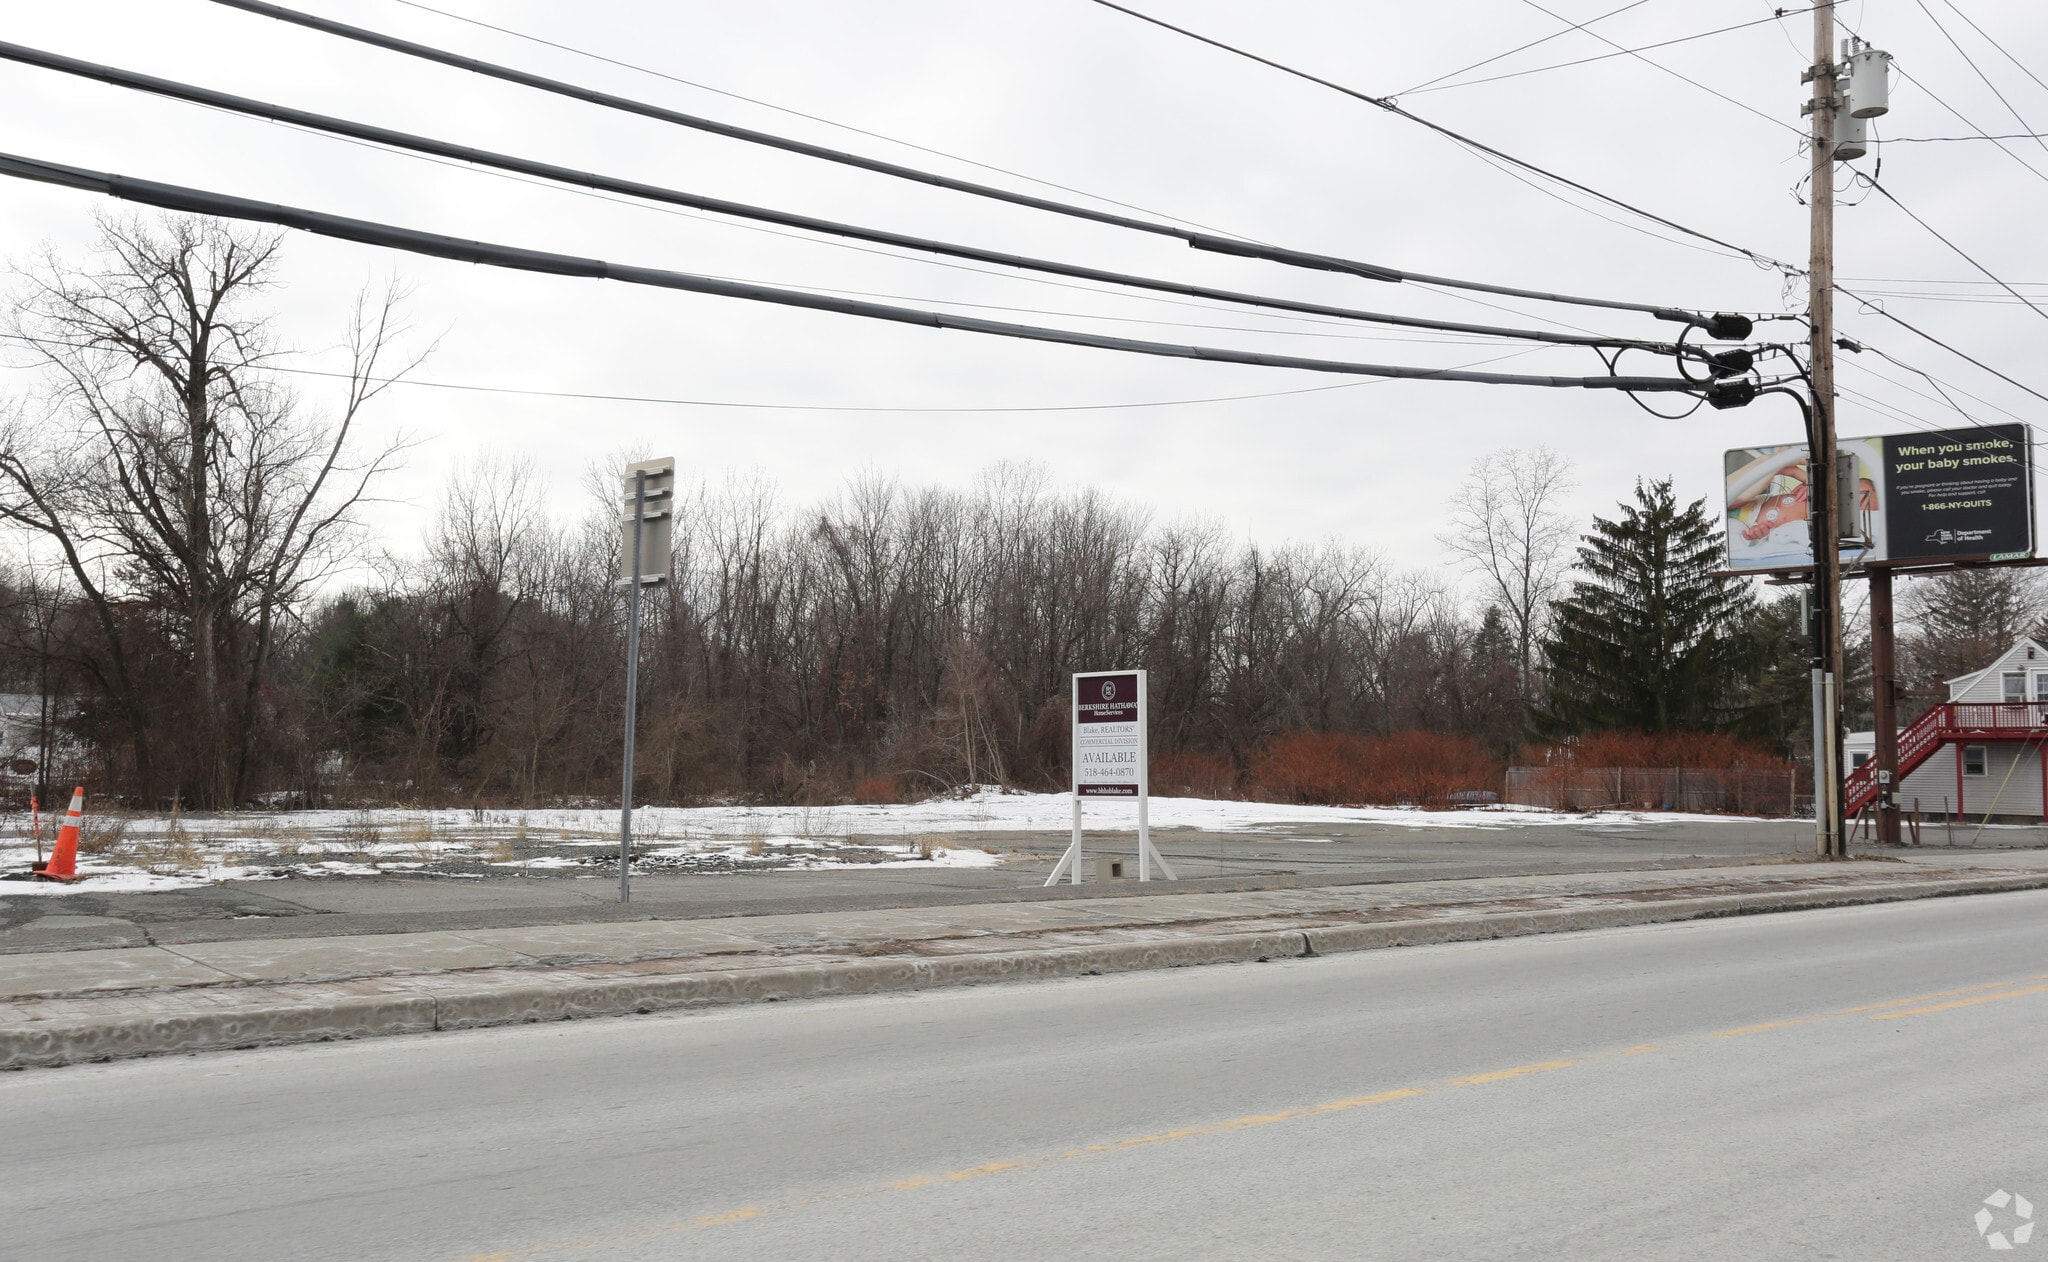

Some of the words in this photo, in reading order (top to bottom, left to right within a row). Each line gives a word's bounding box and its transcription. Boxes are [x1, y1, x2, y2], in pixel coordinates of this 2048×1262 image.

[1898, 446, 1935, 456] When
[1938, 444, 1962, 455] you
[1966, 439, 2014, 451] smoke,
[1896, 462, 1924, 474] your
[1928, 458, 1960, 469] baby
[1962, 454, 2017, 466] smokes.
[1921, 499, 1992, 511] 1-866-NY-QUITS
[1078, 703, 1109, 711] BERKSHIRE
[1083, 752, 1136, 763] AVAILABLE
[1084, 768, 1134, 776] 518-464-0870
